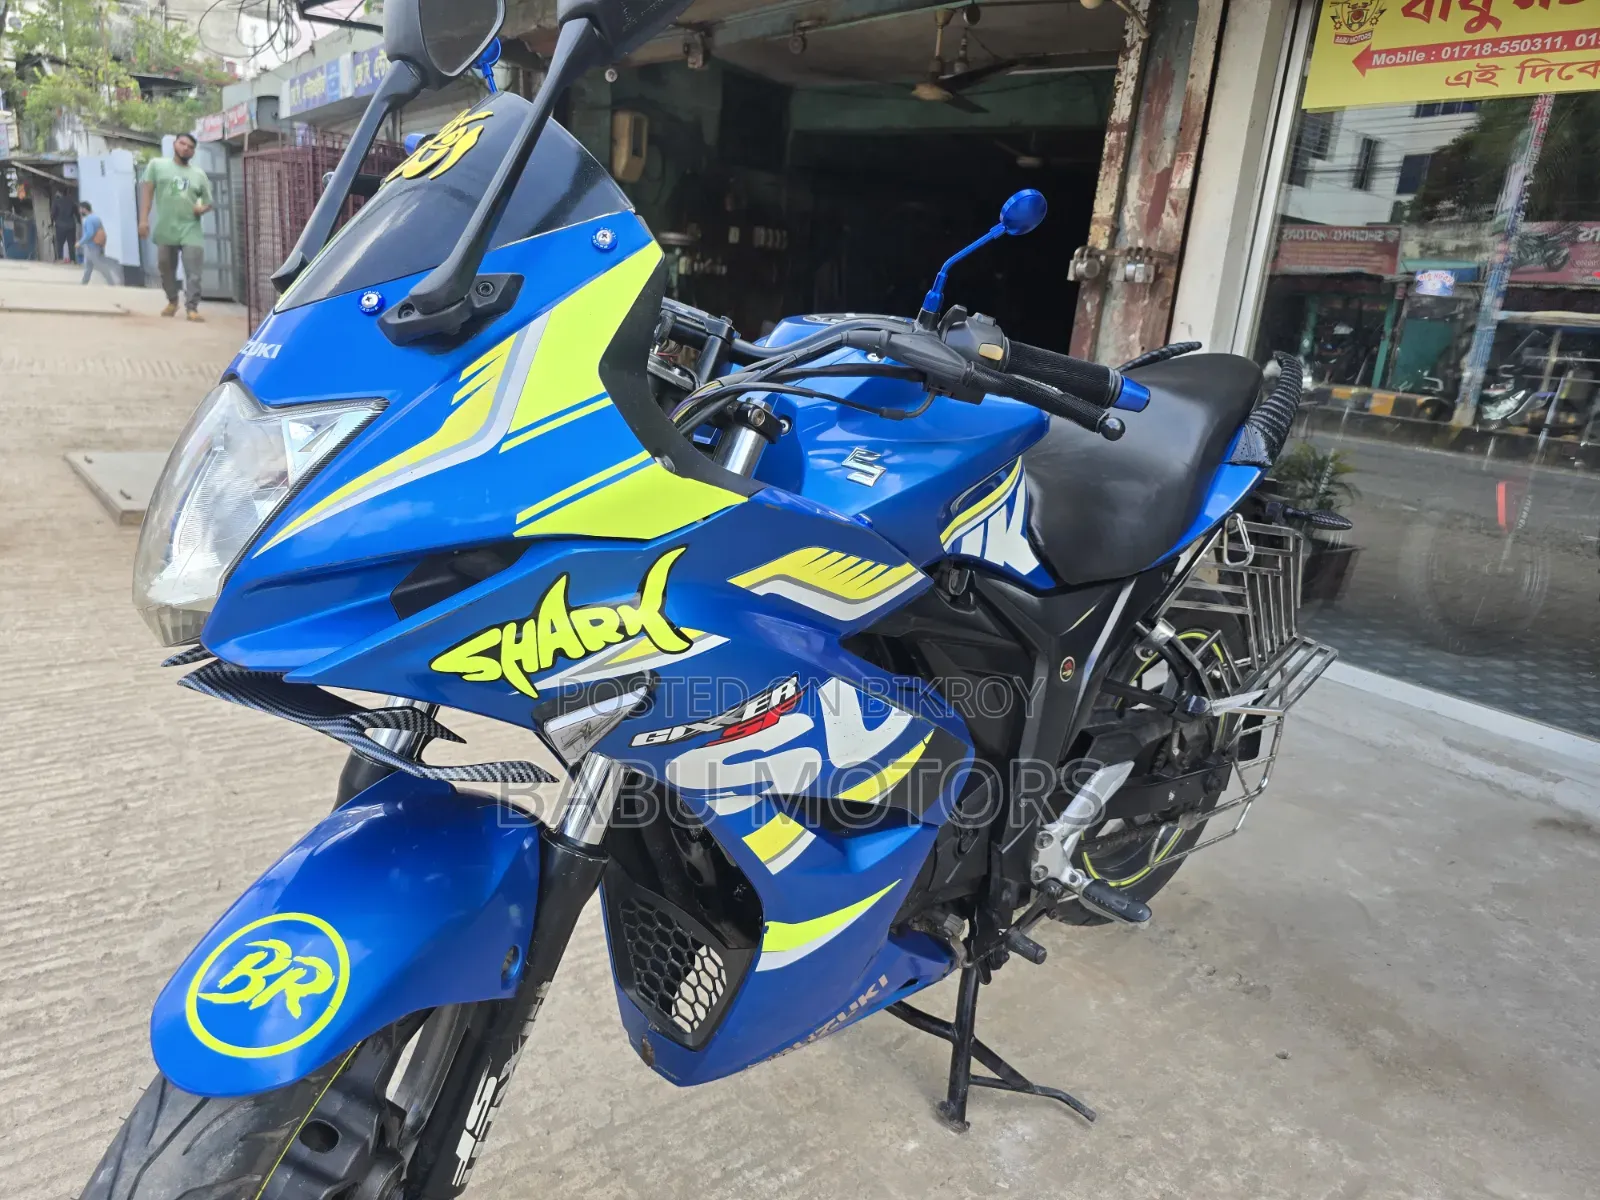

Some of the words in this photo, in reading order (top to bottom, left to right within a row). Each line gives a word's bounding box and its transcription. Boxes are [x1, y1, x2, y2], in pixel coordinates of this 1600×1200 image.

[1372, 50, 1426, 66] Mobile
[1441, 36, 1568, 59] 01718-550311,
[1444, 62, 1506, 88] এই
[430, 546, 694, 699] SHARK
[630, 674, 799, 748] GIXXER
[197, 938, 336, 1020] BR
